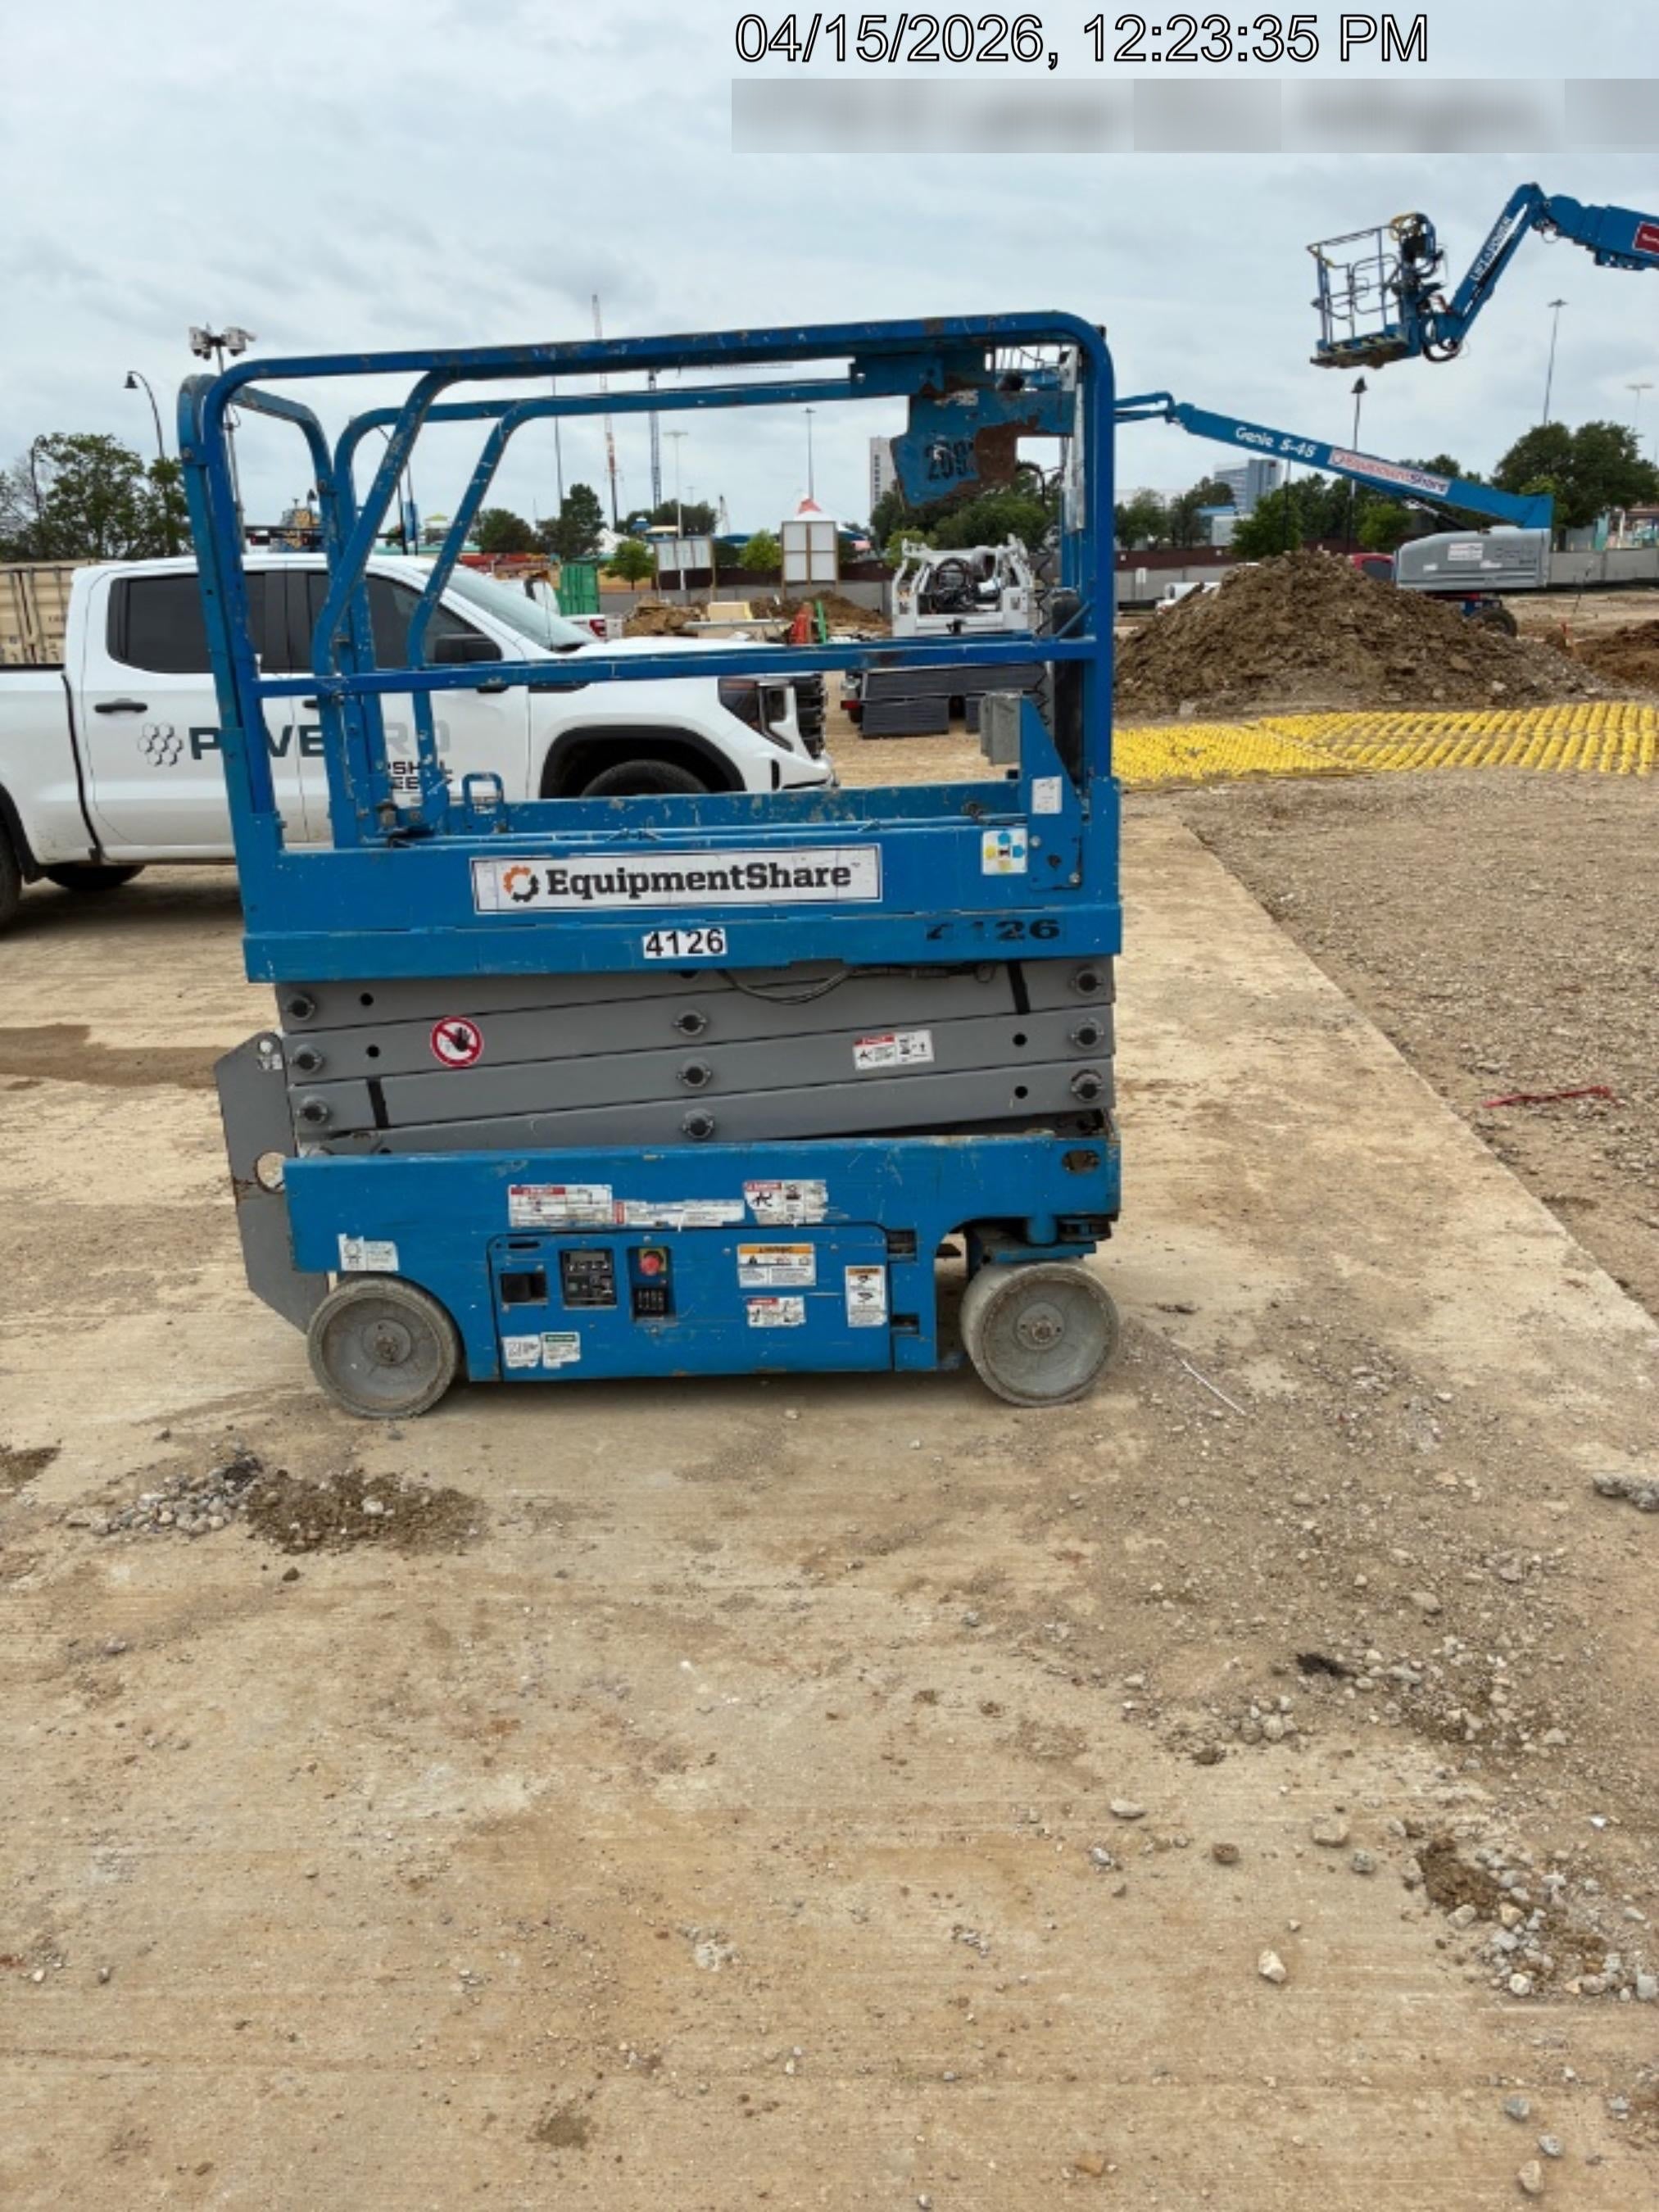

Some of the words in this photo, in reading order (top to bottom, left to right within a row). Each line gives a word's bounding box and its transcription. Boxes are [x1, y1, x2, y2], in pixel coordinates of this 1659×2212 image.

[1235, 426, 1274, 447] Genie
[546, 862, 853, 901] EquipmentShare
[646, 928, 723, 957] 4126
